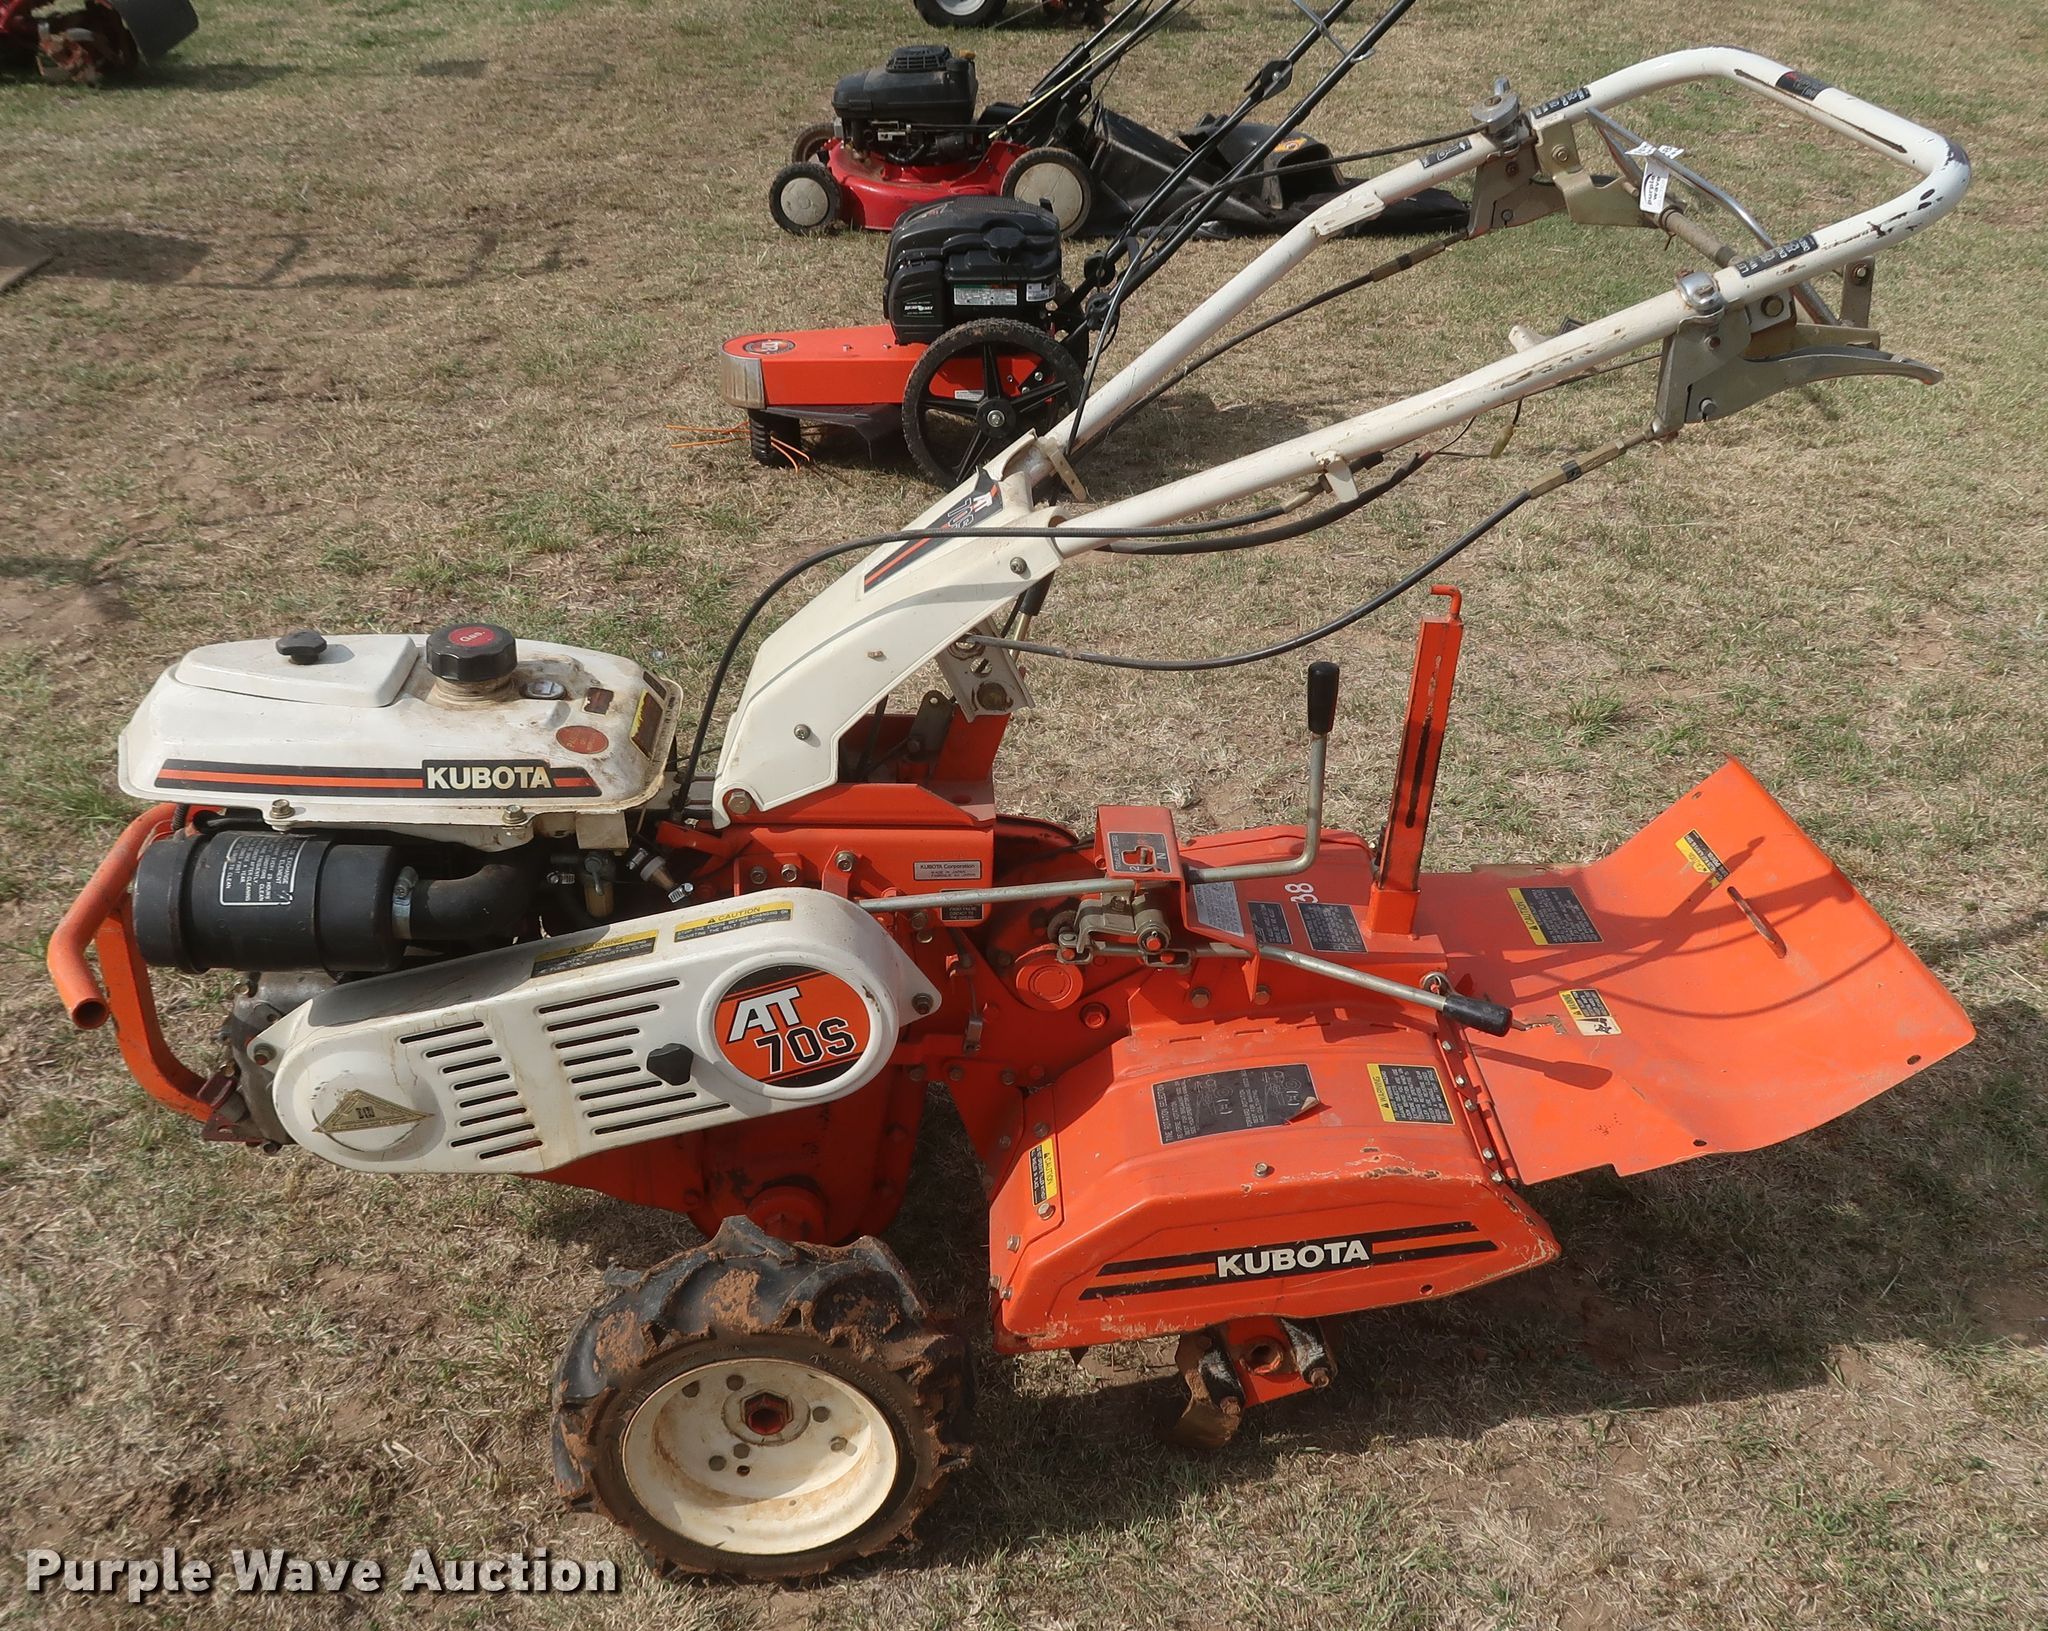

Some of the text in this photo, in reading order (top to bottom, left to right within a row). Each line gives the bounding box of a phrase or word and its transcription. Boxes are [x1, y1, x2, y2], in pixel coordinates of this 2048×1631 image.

[427, 766, 551, 790] KUBOTA
[718, 905, 761, 924] CAUTION
[580, 937, 623, 954] WARNING
[727, 986, 801, 1043] AT
[754, 1016, 857, 1074] 70S
[1372, 1075, 1388, 1105] WARNING
[1217, 1239, 1370, 1278] KUBOTA
